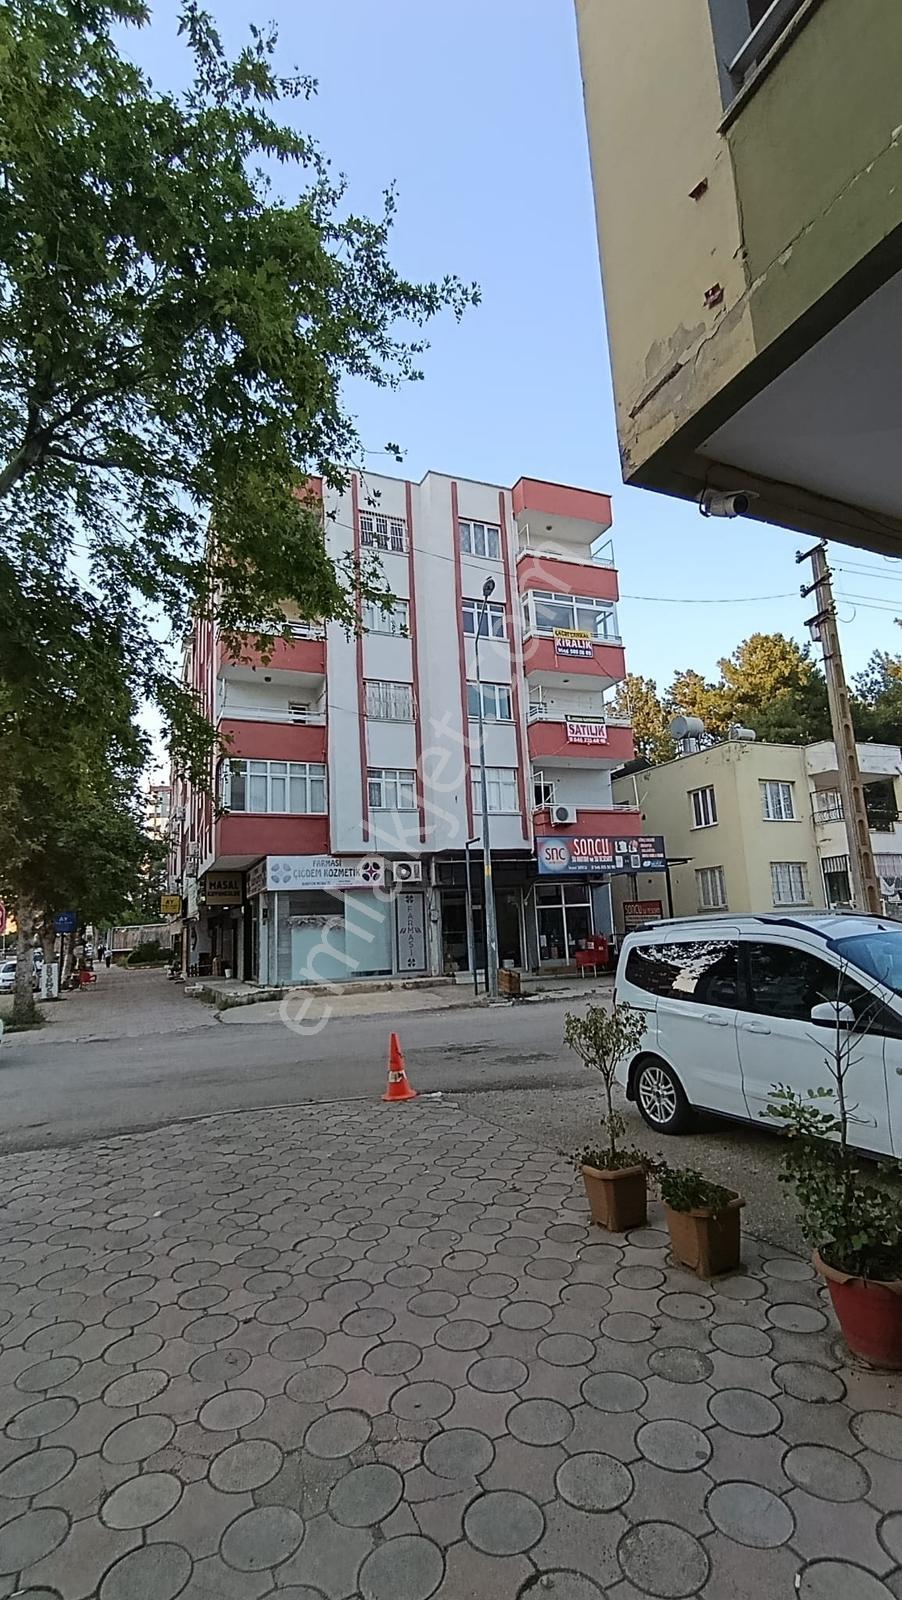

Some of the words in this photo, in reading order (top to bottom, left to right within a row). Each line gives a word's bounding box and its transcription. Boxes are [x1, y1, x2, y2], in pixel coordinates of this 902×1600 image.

[556, 638, 592, 650] KIRALIK
[568, 724, 605, 738] SATILIK
[209, 880, 239, 890] MASAL
